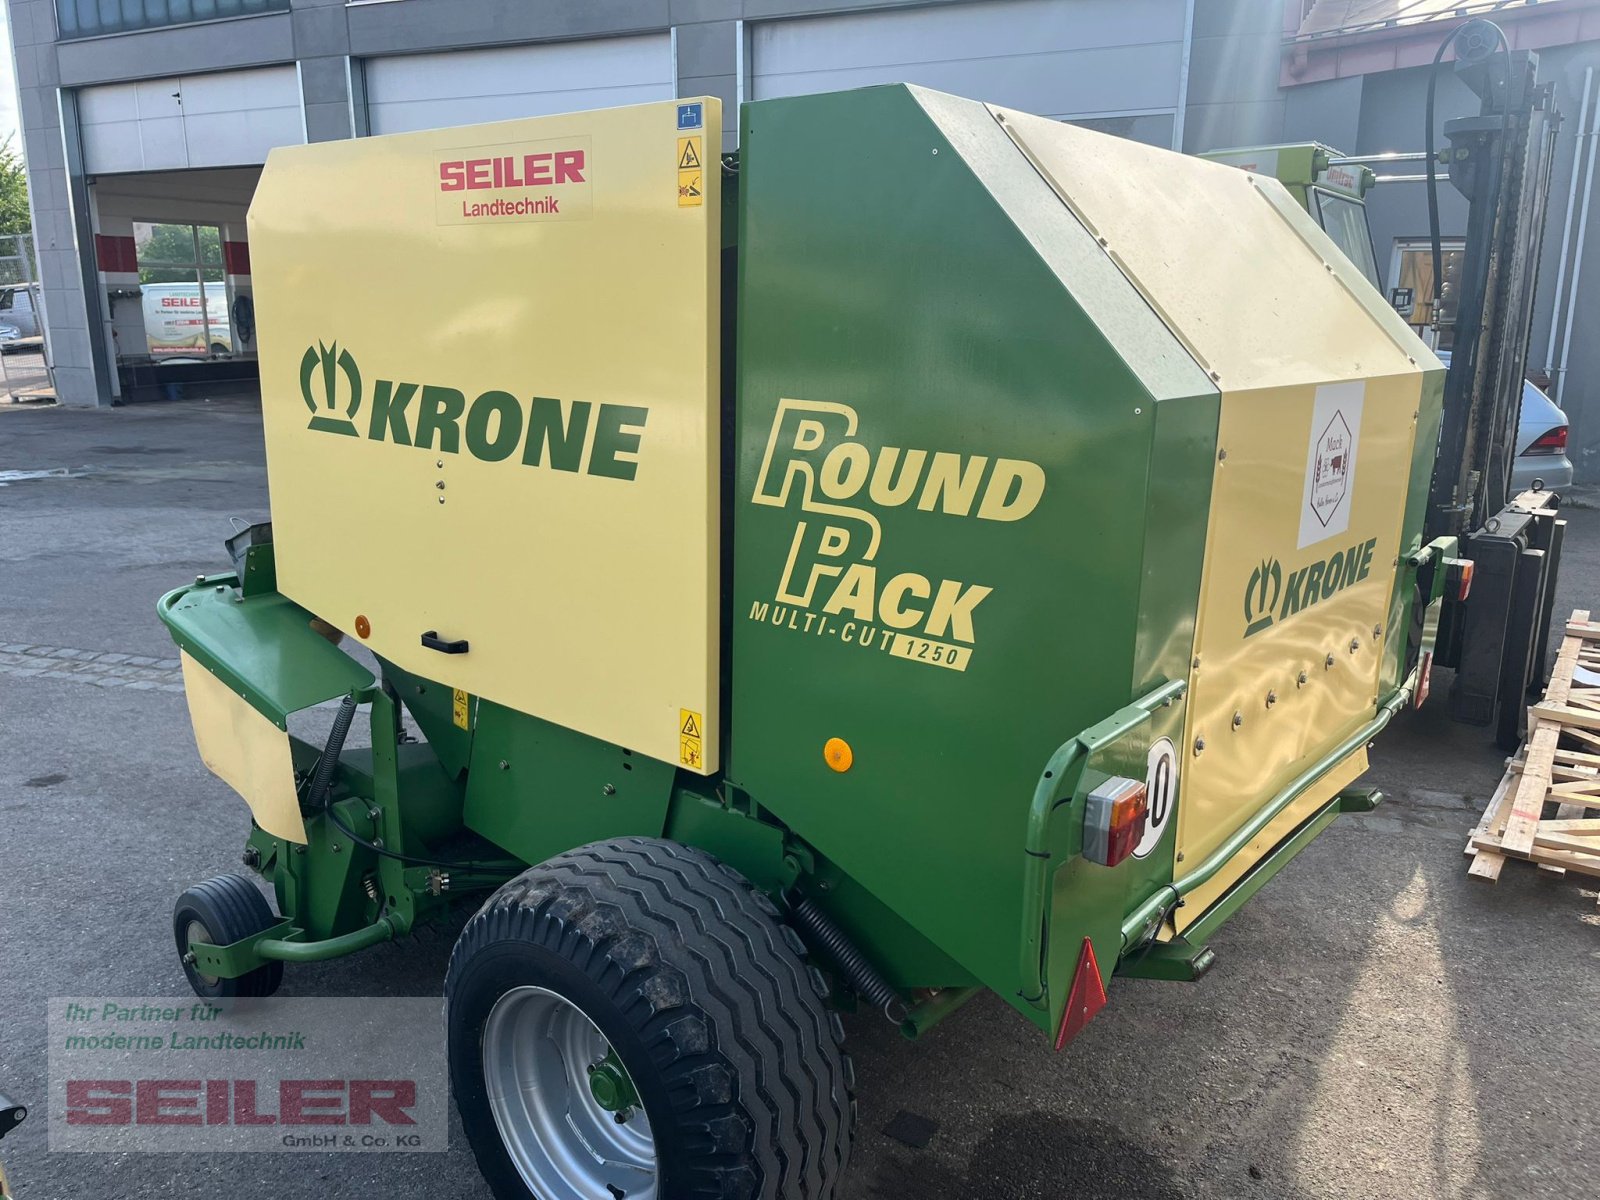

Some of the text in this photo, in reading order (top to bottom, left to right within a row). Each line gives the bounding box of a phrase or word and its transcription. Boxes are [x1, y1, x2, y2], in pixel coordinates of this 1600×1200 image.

[440, 150, 586, 192] SEILER
[463, 196, 559, 217] Landtechnik
[368, 379, 649, 482] KRONE
[751, 398, 1046, 522] ROUND
[775, 501, 994, 644] PACK
[1279, 537, 1377, 621] KRONE
[749, 600, 959, 666] MULTI-CUT 1250
